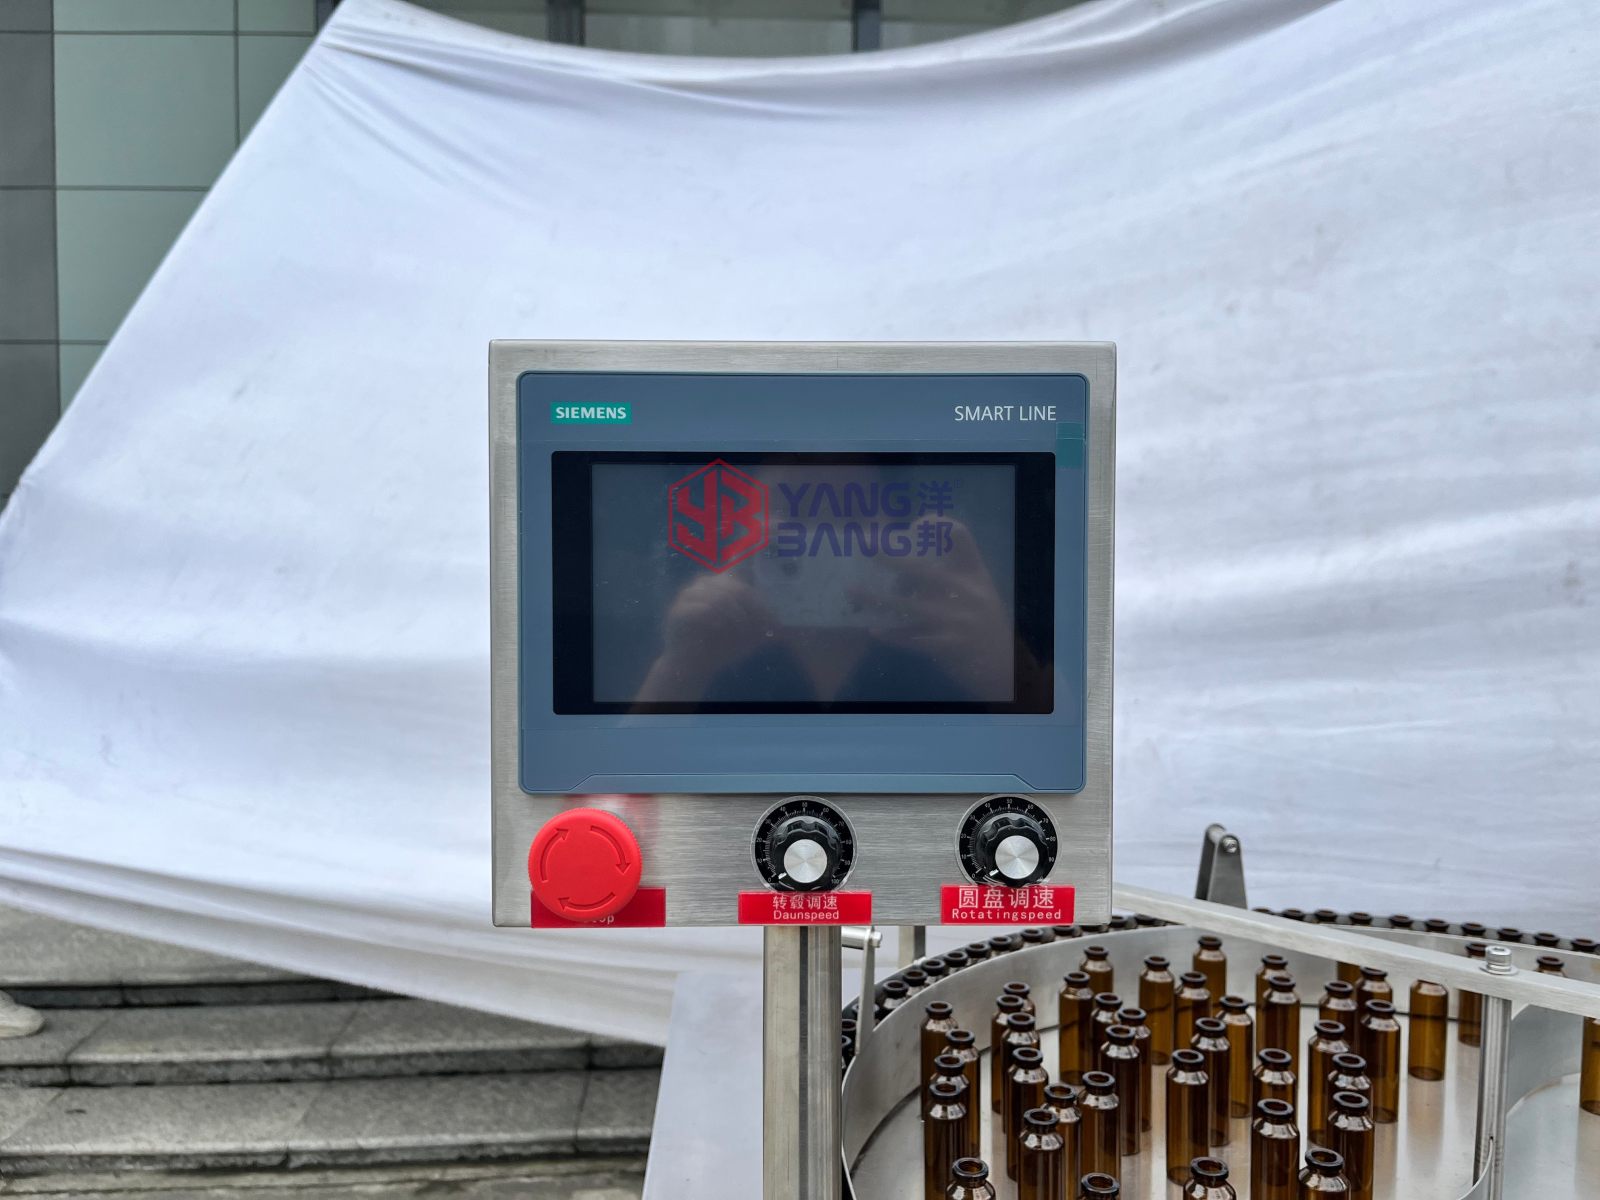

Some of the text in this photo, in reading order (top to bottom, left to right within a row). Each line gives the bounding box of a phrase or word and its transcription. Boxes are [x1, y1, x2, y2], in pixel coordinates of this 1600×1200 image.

[556, 406, 627, 419] SIEMENS
[954, 405, 1057, 421] SMART LINE
[959, 885, 1055, 909] 圆盘调速
[773, 910, 840, 921] Daunspeed
[951, 908, 1062, 921] Rotatingspeed
